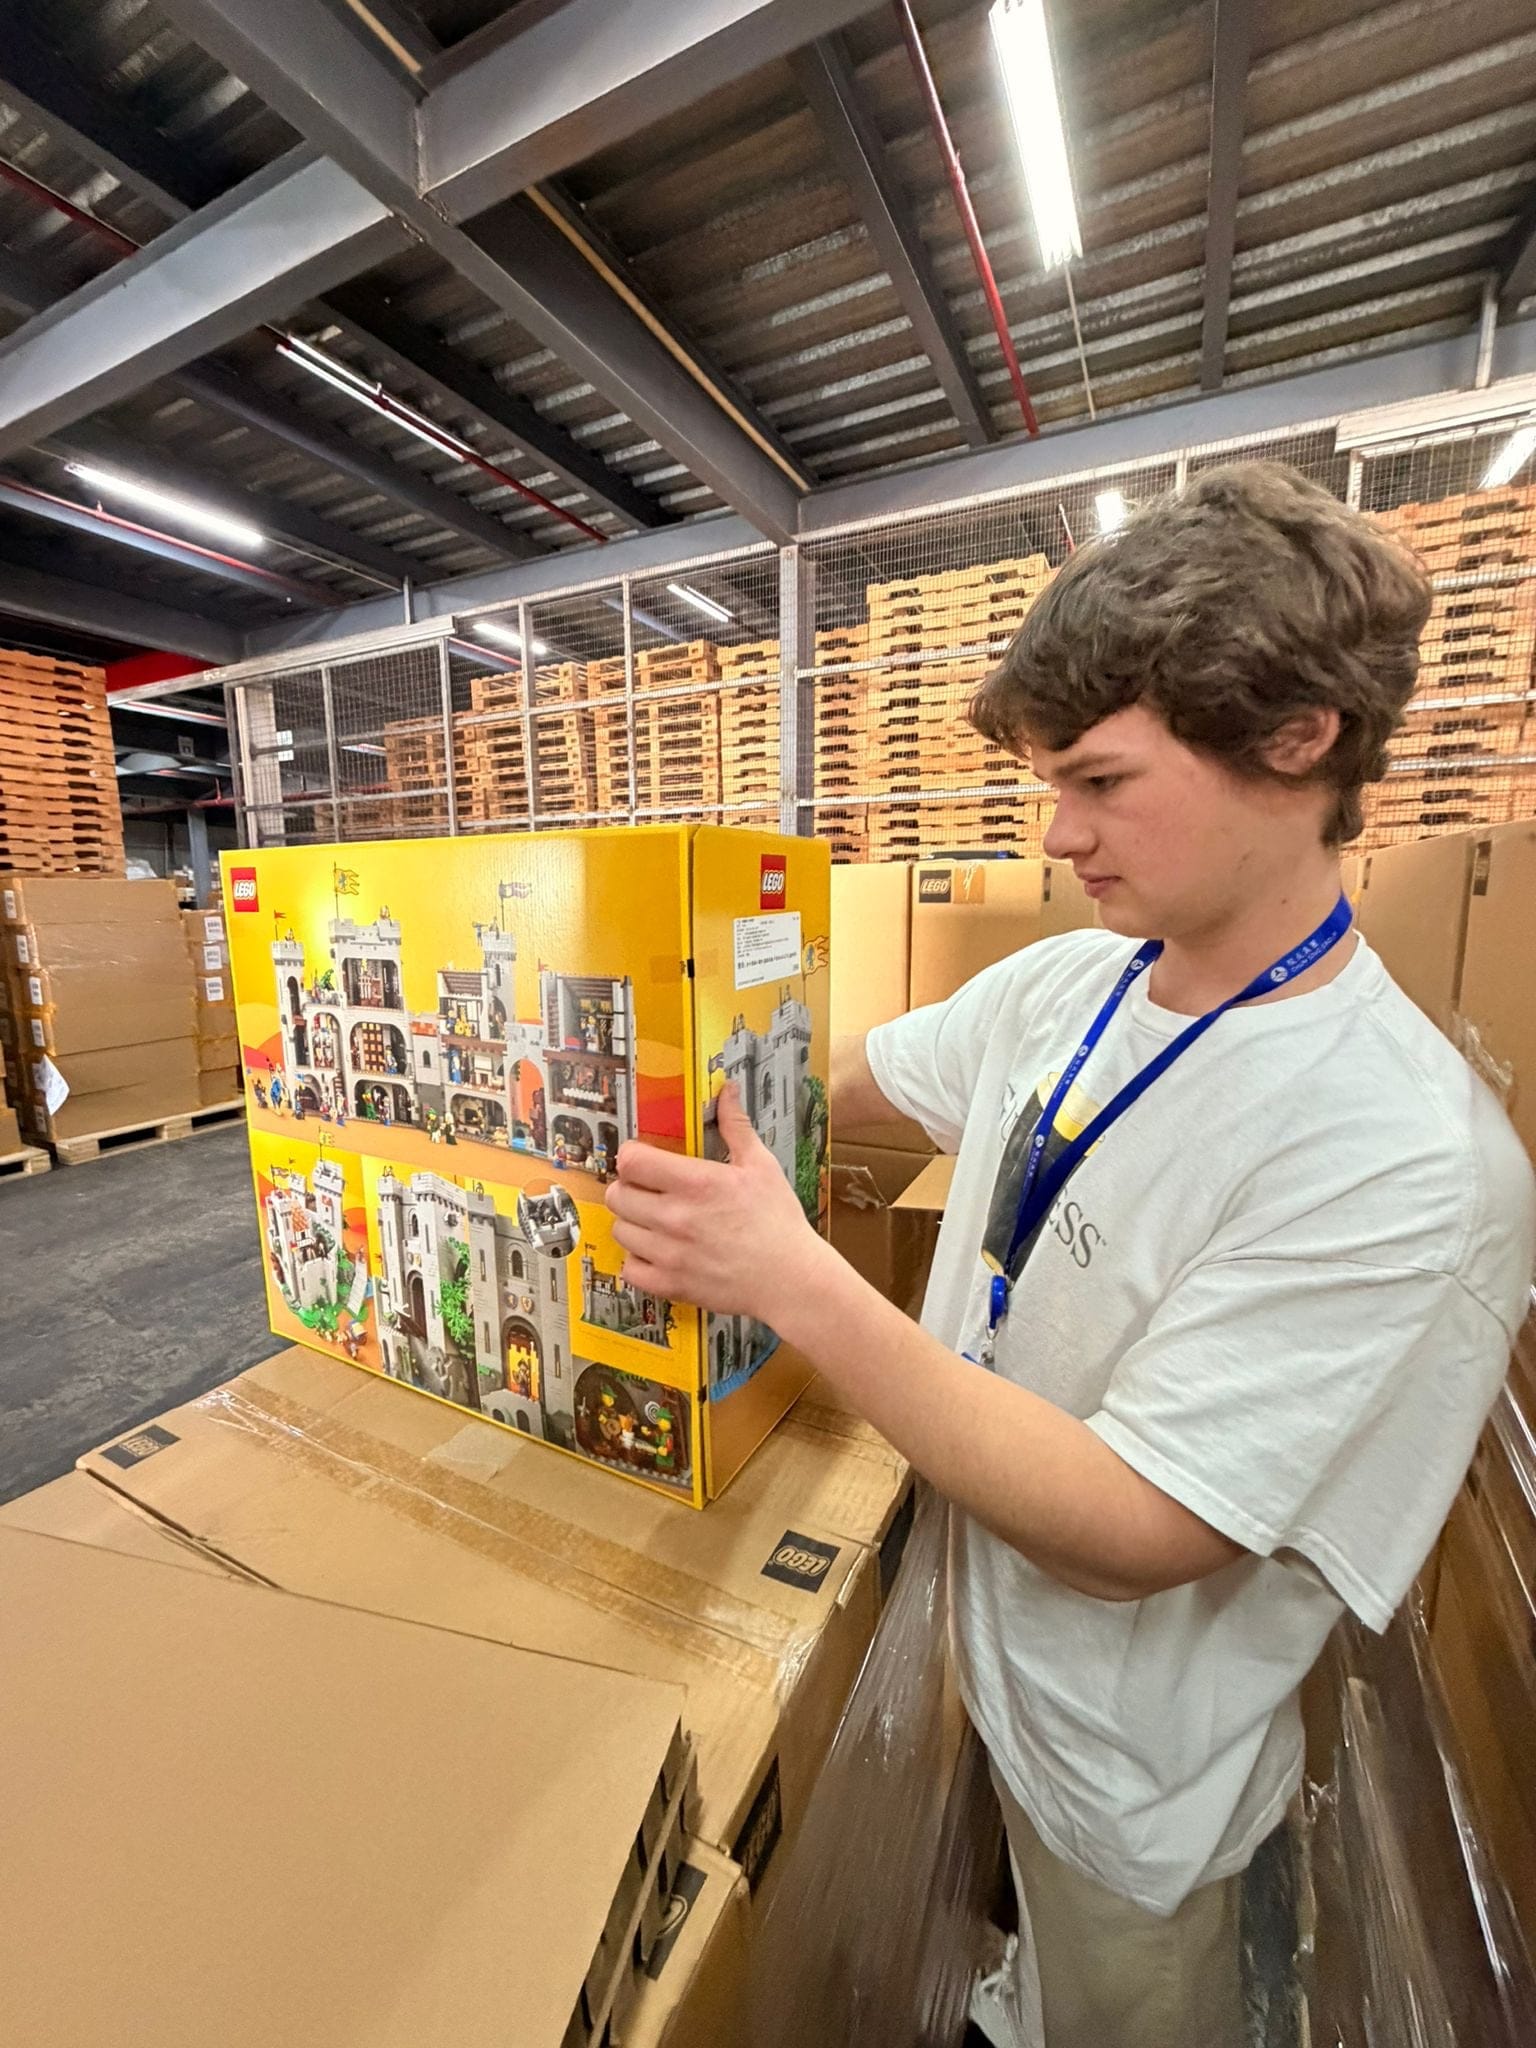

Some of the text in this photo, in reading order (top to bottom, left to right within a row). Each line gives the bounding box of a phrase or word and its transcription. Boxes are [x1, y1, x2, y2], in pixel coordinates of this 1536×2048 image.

[234, 881, 256, 898] LEGO
[762, 872, 784, 892] LEGO
[920, 879, 949, 894] LEGO
[775, 1547, 829, 1575] LEGO
